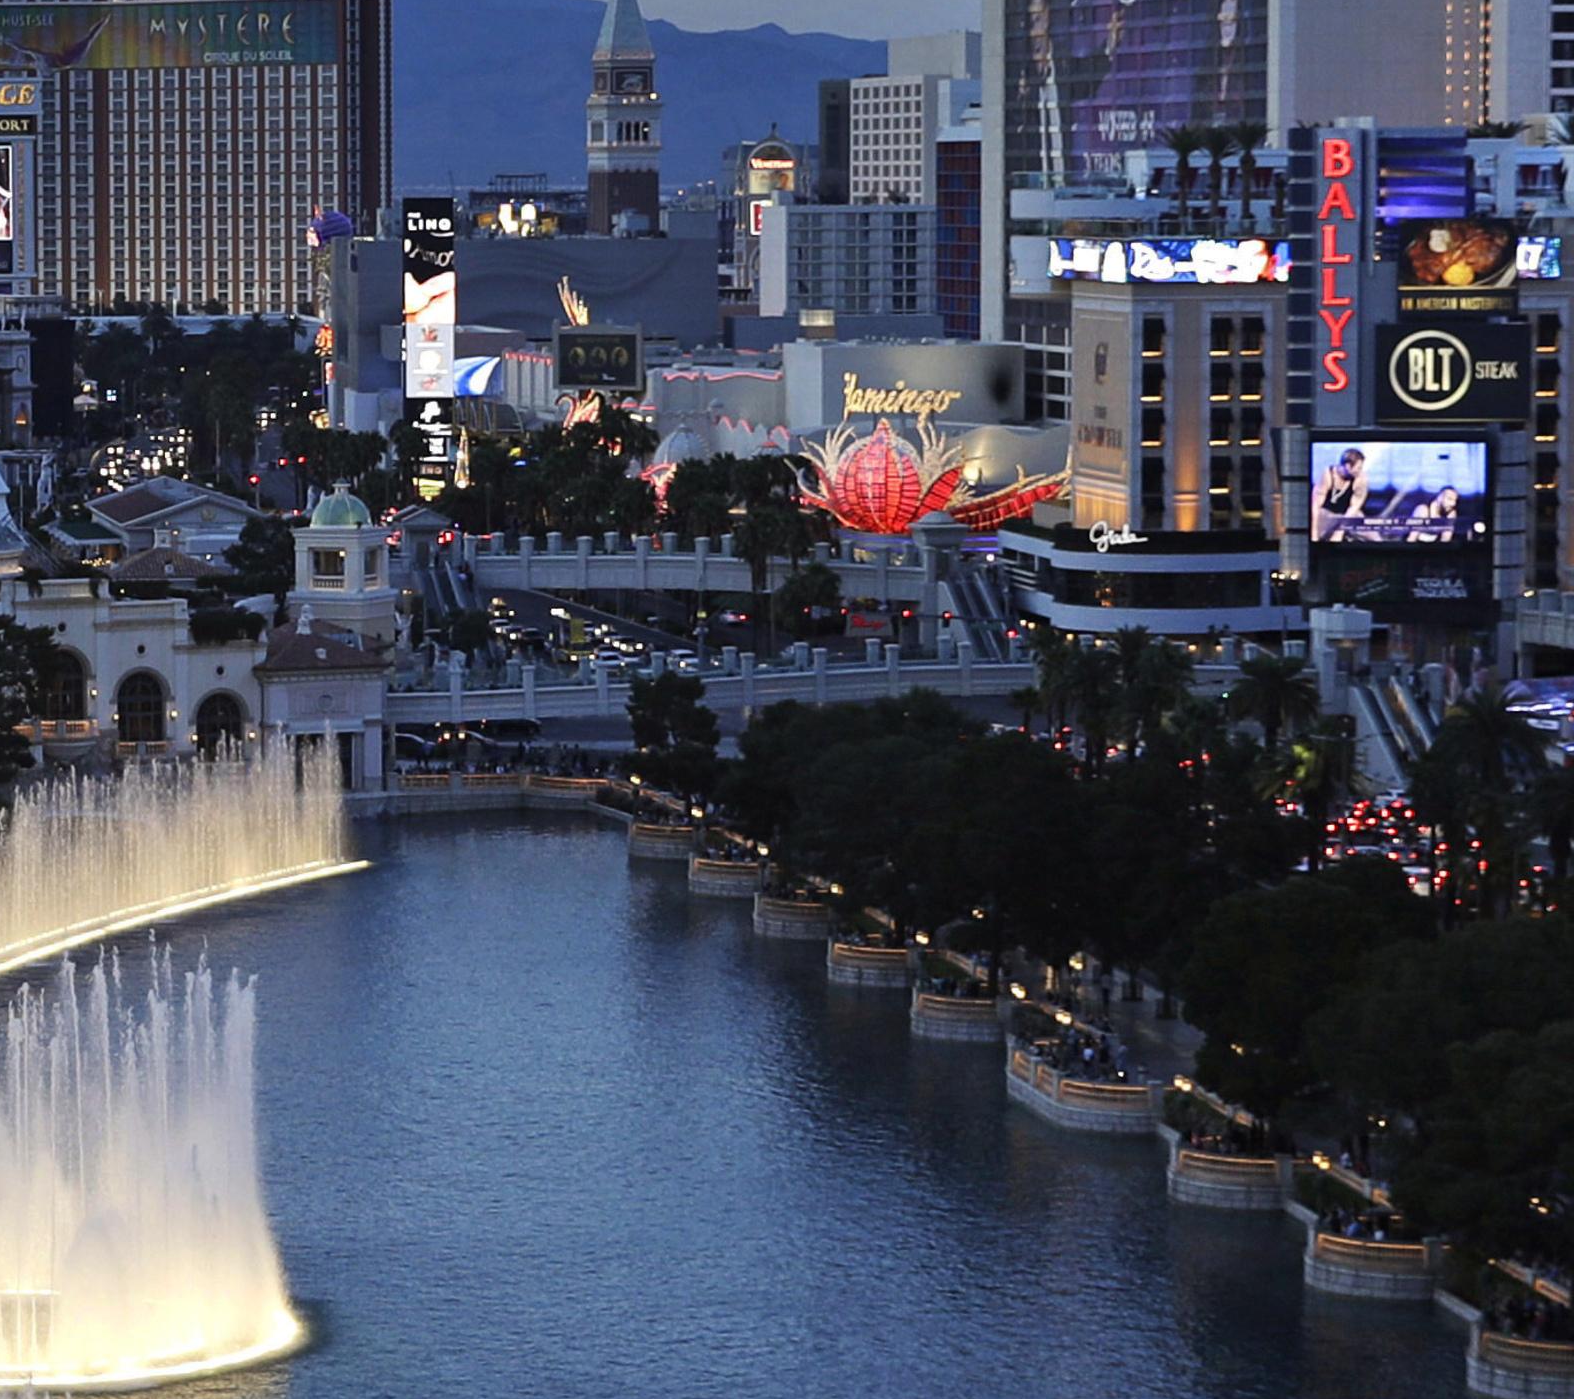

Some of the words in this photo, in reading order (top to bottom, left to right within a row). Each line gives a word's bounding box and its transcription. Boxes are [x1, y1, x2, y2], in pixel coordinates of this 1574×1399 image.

[1319, 138, 1356, 393] BALLYS
[1407, 346, 1455, 392] BLT
[1474, 360, 1519, 379] STEAK
